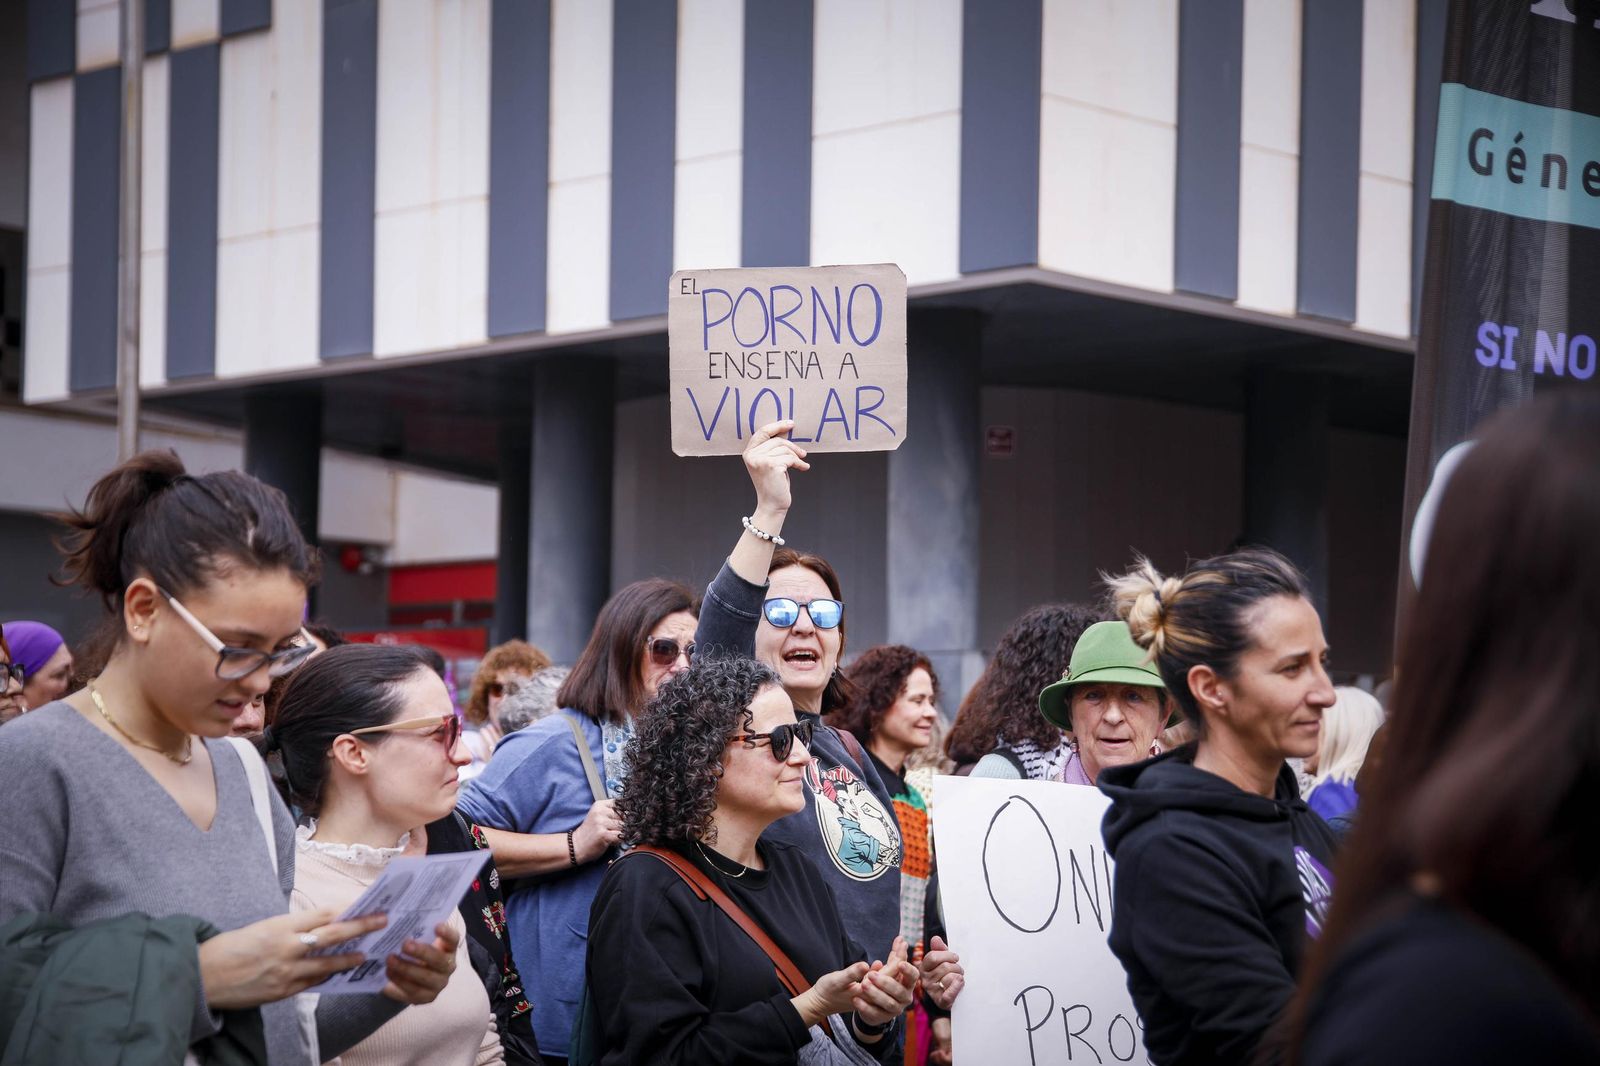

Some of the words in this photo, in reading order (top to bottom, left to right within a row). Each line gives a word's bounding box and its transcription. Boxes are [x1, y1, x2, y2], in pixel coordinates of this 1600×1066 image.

[1467, 127, 1600, 197] Géne
[680, 277, 700, 295] EL
[702, 283, 882, 350] PORNO
[708, 350, 824, 380] ENSEÑA
[838, 352, 859, 380] A
[1474, 321, 1519, 371] SI
[1533, 329, 1597, 380] NO
[685, 385, 896, 443] VIOLAR
